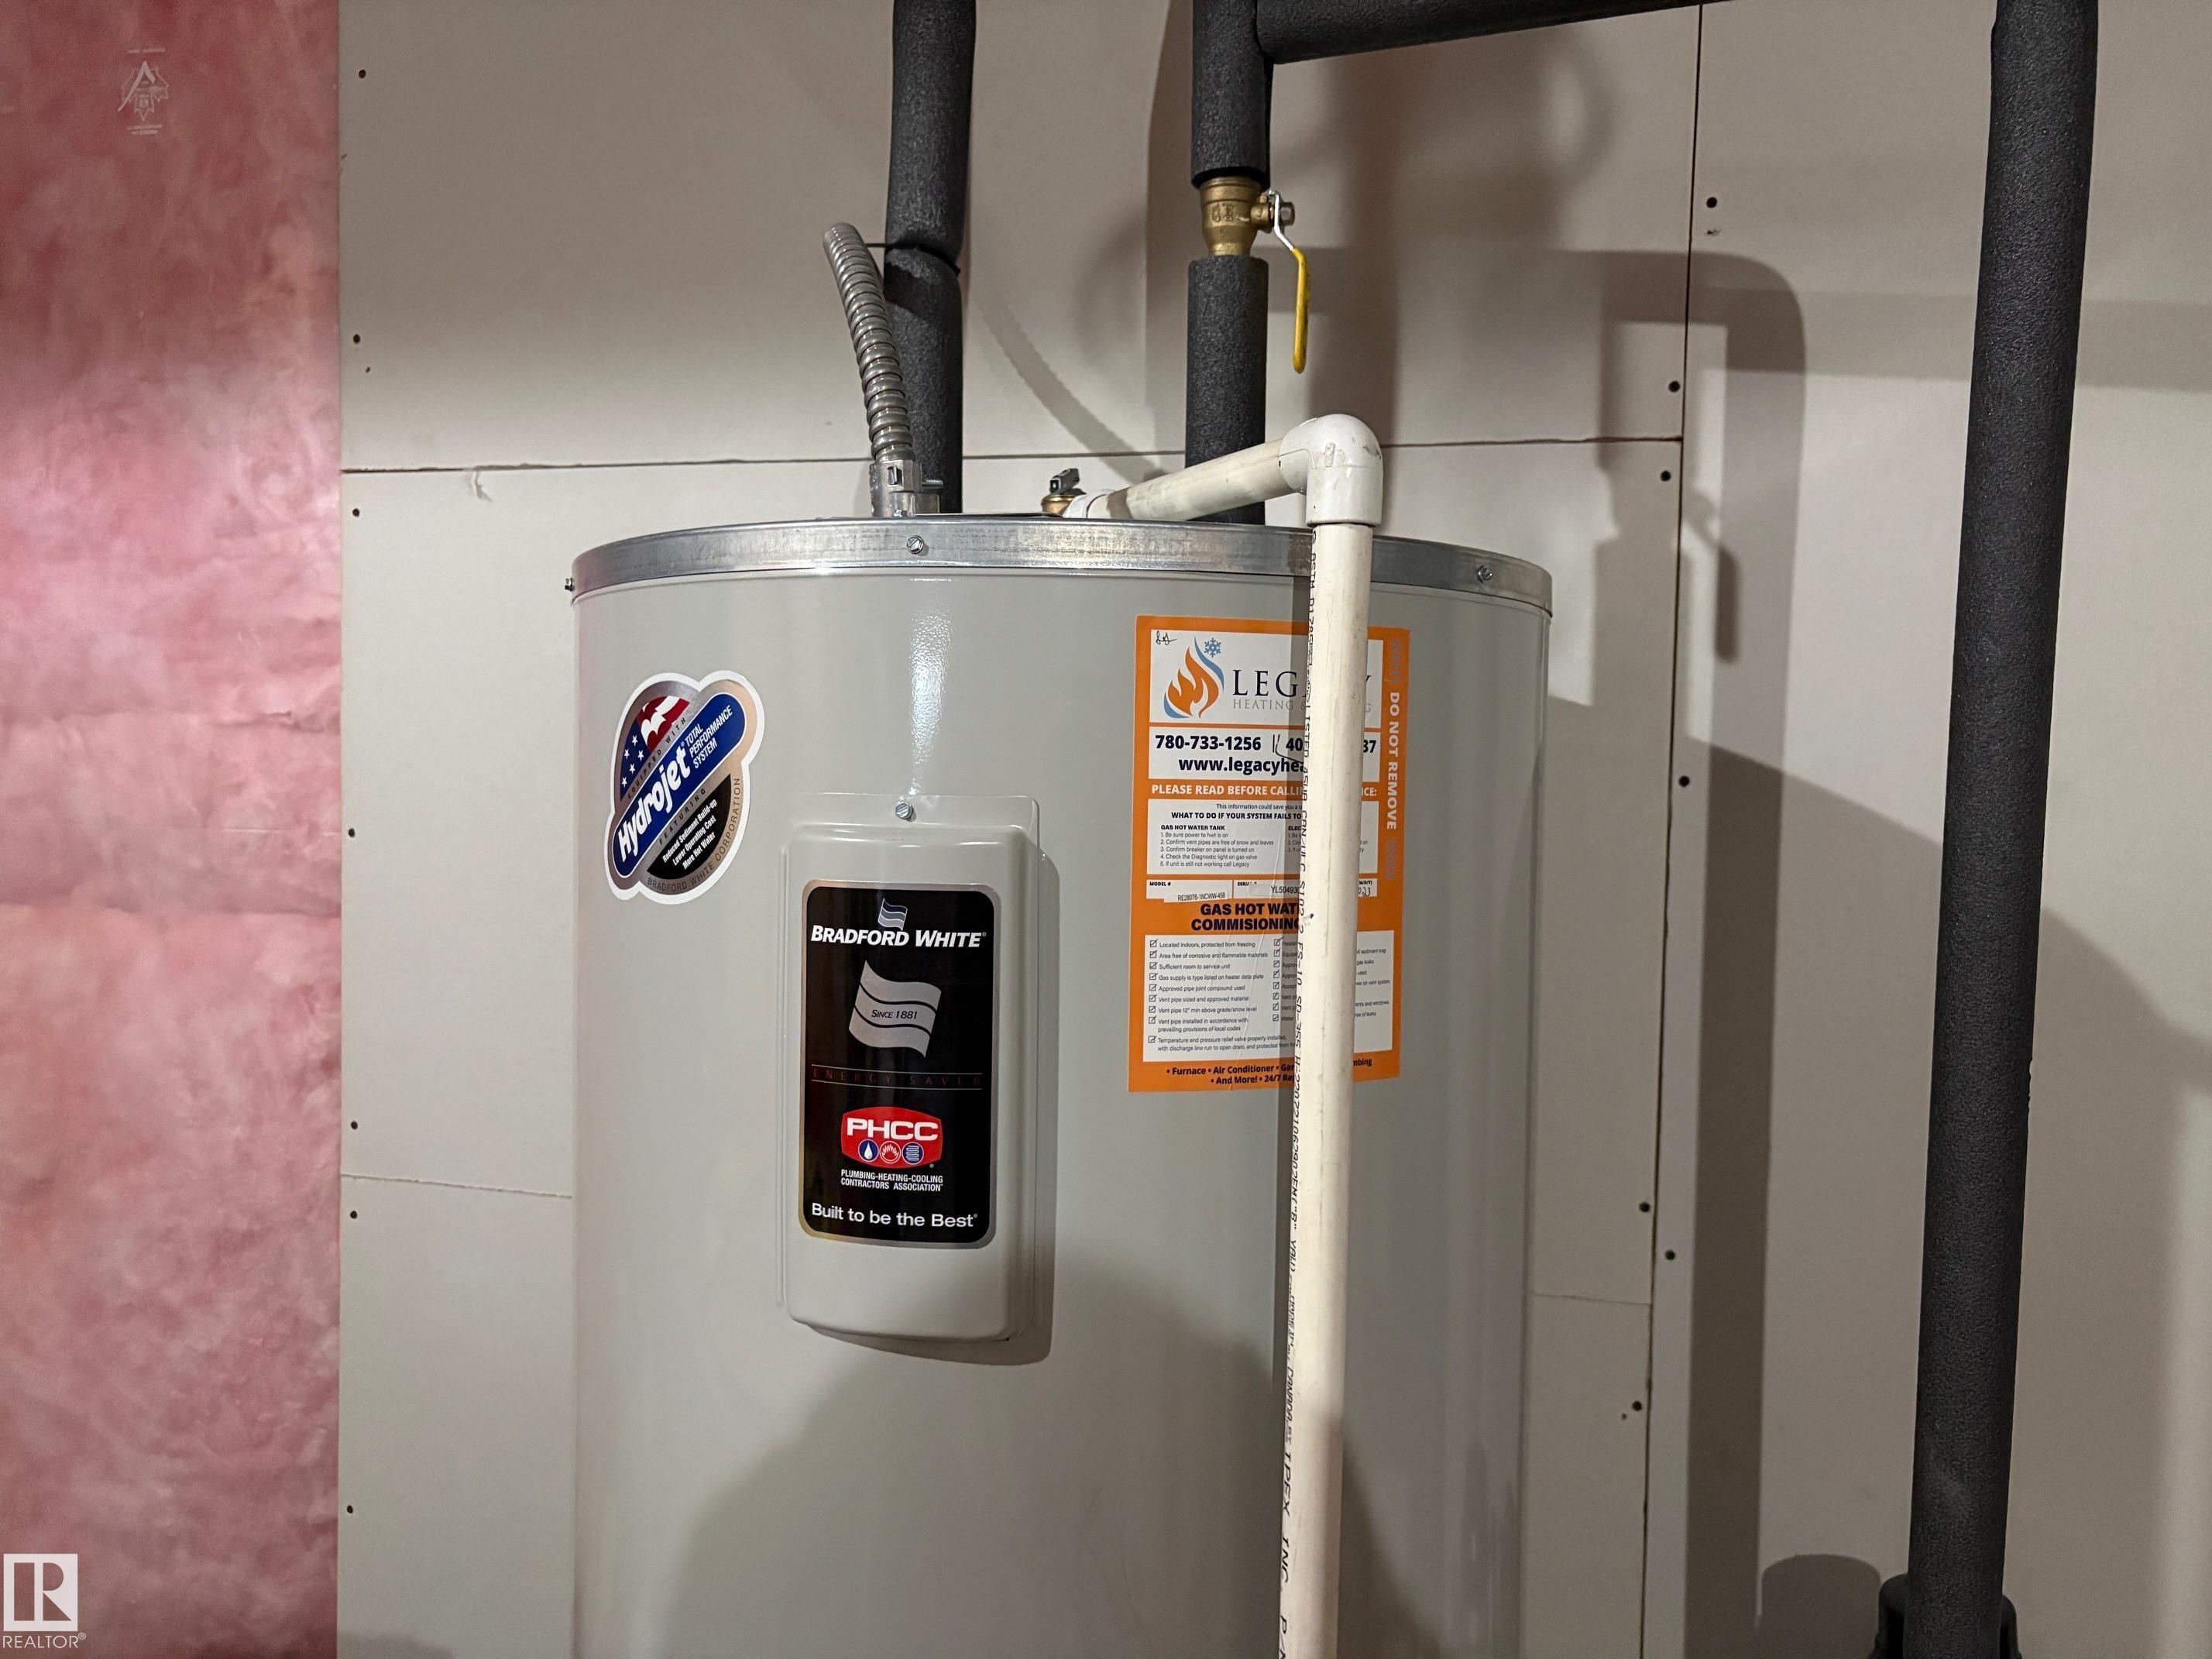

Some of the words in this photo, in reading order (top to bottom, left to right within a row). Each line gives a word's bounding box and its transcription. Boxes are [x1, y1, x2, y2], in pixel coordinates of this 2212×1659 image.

[1233, 699, 1293, 710] HEATING
[1389, 692, 1400, 716] DO
[685, 723, 702, 747] TOTAL
[689, 705, 733, 757] PERFORMANCE
[1156, 735, 1261, 750] 780-733-1256
[1389, 721, 1399, 757] NOT
[627, 750, 661, 799] EQUIPPED
[666, 718, 685, 744] WITH
[693, 740, 718, 768] SYSTEM
[1152, 785, 1191, 794] PLEASE
[1196, 785, 1224, 795] READ
[1228, 786, 1267, 795] BEFORE
[1270, 787, 1303, 795] CALLI
[1386, 761, 1397, 830] REMOVE
[659, 788, 706, 844] FEATURING
[647, 877, 687, 891] BRADFORD
[690, 864, 715, 885] WHITE
[716, 778, 740, 861] CORPORATION
[663, 842, 680, 864] Reduced
[678, 821, 699, 849] Sediment
[698, 799, 718, 823] Build-up
[672, 848, 686, 865] Lower
[685, 829, 706, 854] Operating
[704, 816, 716, 830] Cost
[682, 854, 695, 869] More
[693, 846, 702, 860] Hot
[702, 832, 716, 849] Water
[1200, 904, 1231, 915] GAS
[1235, 904, 1264, 915] HOT
[1268, 904, 1300, 915] WAT
[811, 925, 909, 946] BRADFORD
[871, 1009, 892, 1018] SINCE
[895, 1010, 917, 1019] 1881
[813, 1069, 891, 1084] ENERGY
[1228, 1064, 1274, 1073] Conditioner
[847, 1117, 938, 1140] PHCC
[841, 1170, 943, 1183] PLUMBING-HEATING-COOLING
[841, 1177, 889, 1189] CONTRACTORS
[812, 1203, 843, 1220] Built
[848, 1207, 864, 1222] to
[870, 1210, 891, 1224] be
[896, 1211, 926, 1227] the
